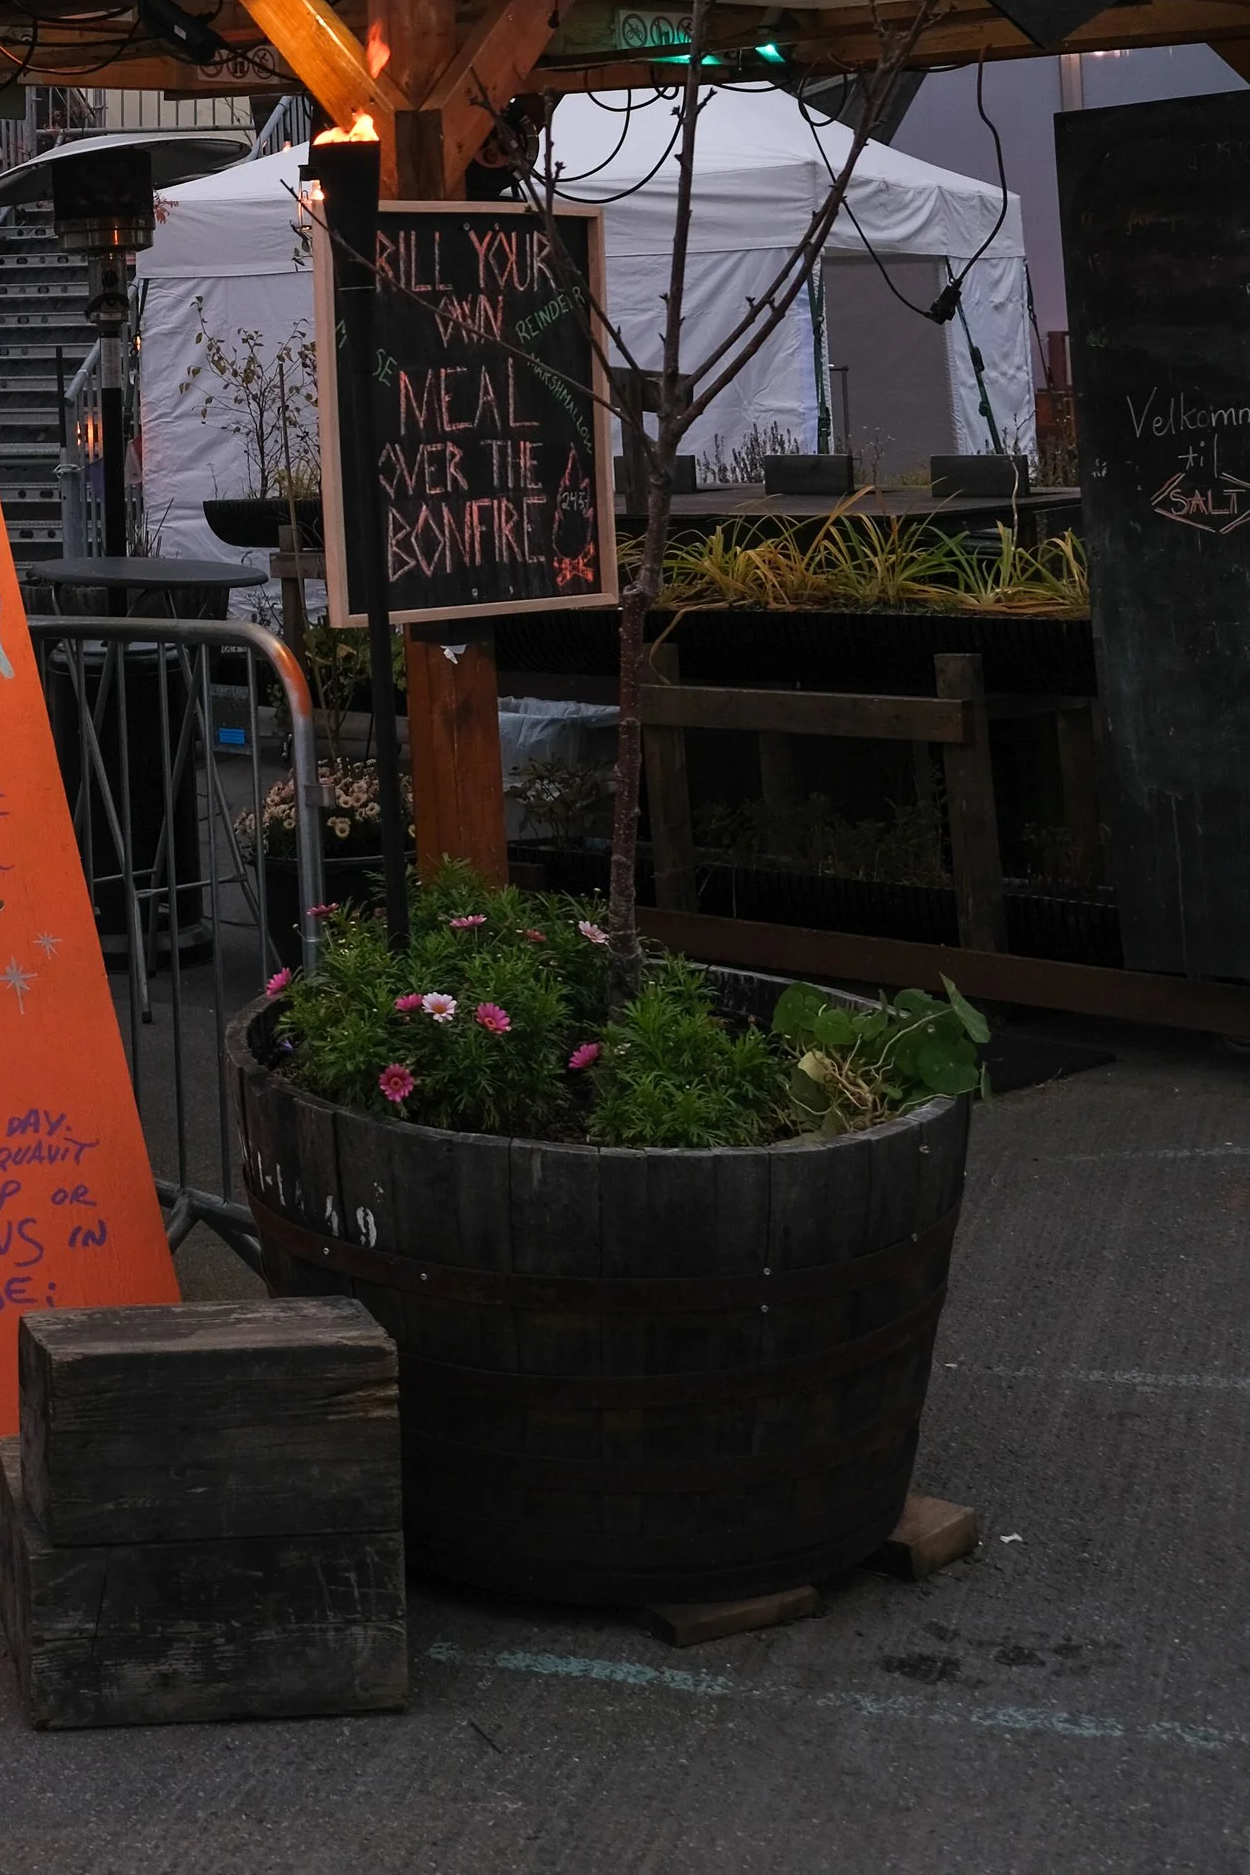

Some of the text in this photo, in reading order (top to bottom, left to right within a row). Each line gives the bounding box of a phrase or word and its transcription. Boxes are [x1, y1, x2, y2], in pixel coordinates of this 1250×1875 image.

[468, 229, 566, 293] YOUR
[400, 357, 540, 436] MEAL
[378, 439, 543, 499] OVER THE
[1170, 488, 1247, 516] SALT
[388, 496, 547, 583] BONFIRE
